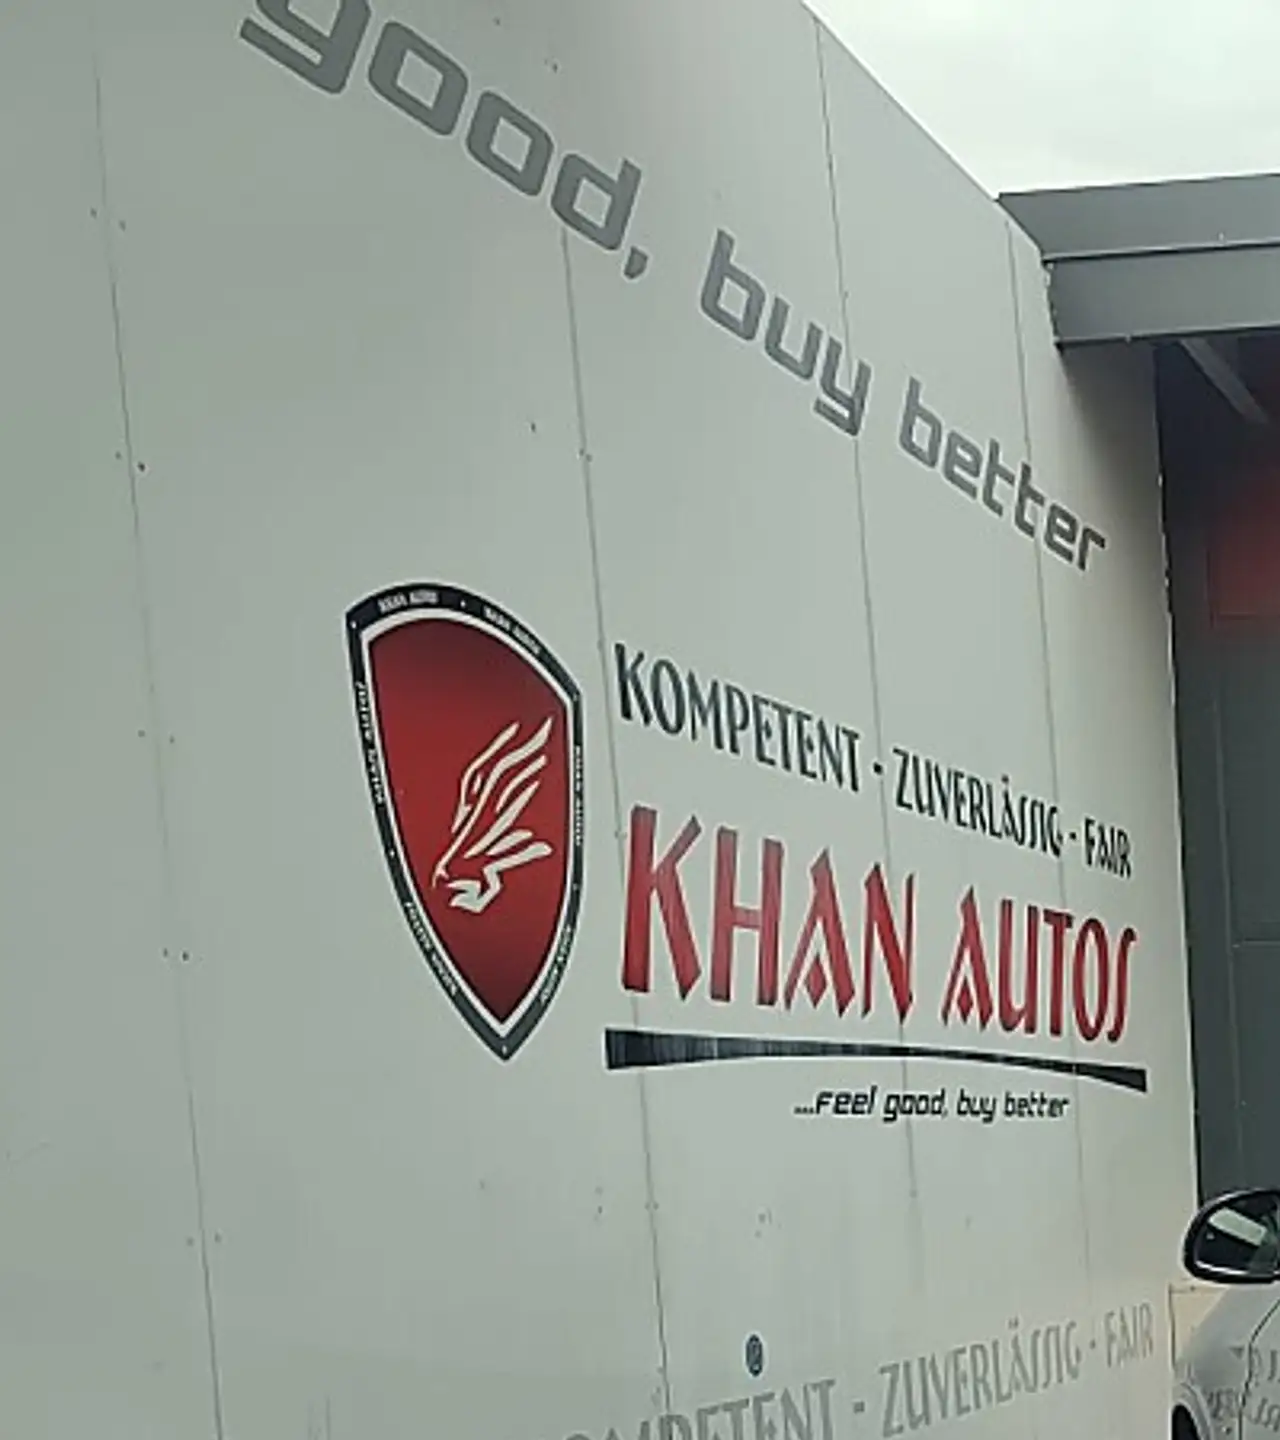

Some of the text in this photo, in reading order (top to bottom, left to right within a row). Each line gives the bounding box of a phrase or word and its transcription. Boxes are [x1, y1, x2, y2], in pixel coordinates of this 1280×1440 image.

[701, 229, 871, 436] buy
[901, 376, 1105, 570] better
[615, 643, 859, 792] KOMPETENT
[1084, 817, 1132, 878] FAIR
[622, 806, 914, 1023] KHAN
[941, 887, 1137, 1042] AUTOS
[883, 1088, 948, 1123] good,
[957, 1089, 996, 1123] buy
[1003, 1092, 1069, 1117] better
[1104, 1303, 1154, 1367] FAIR
